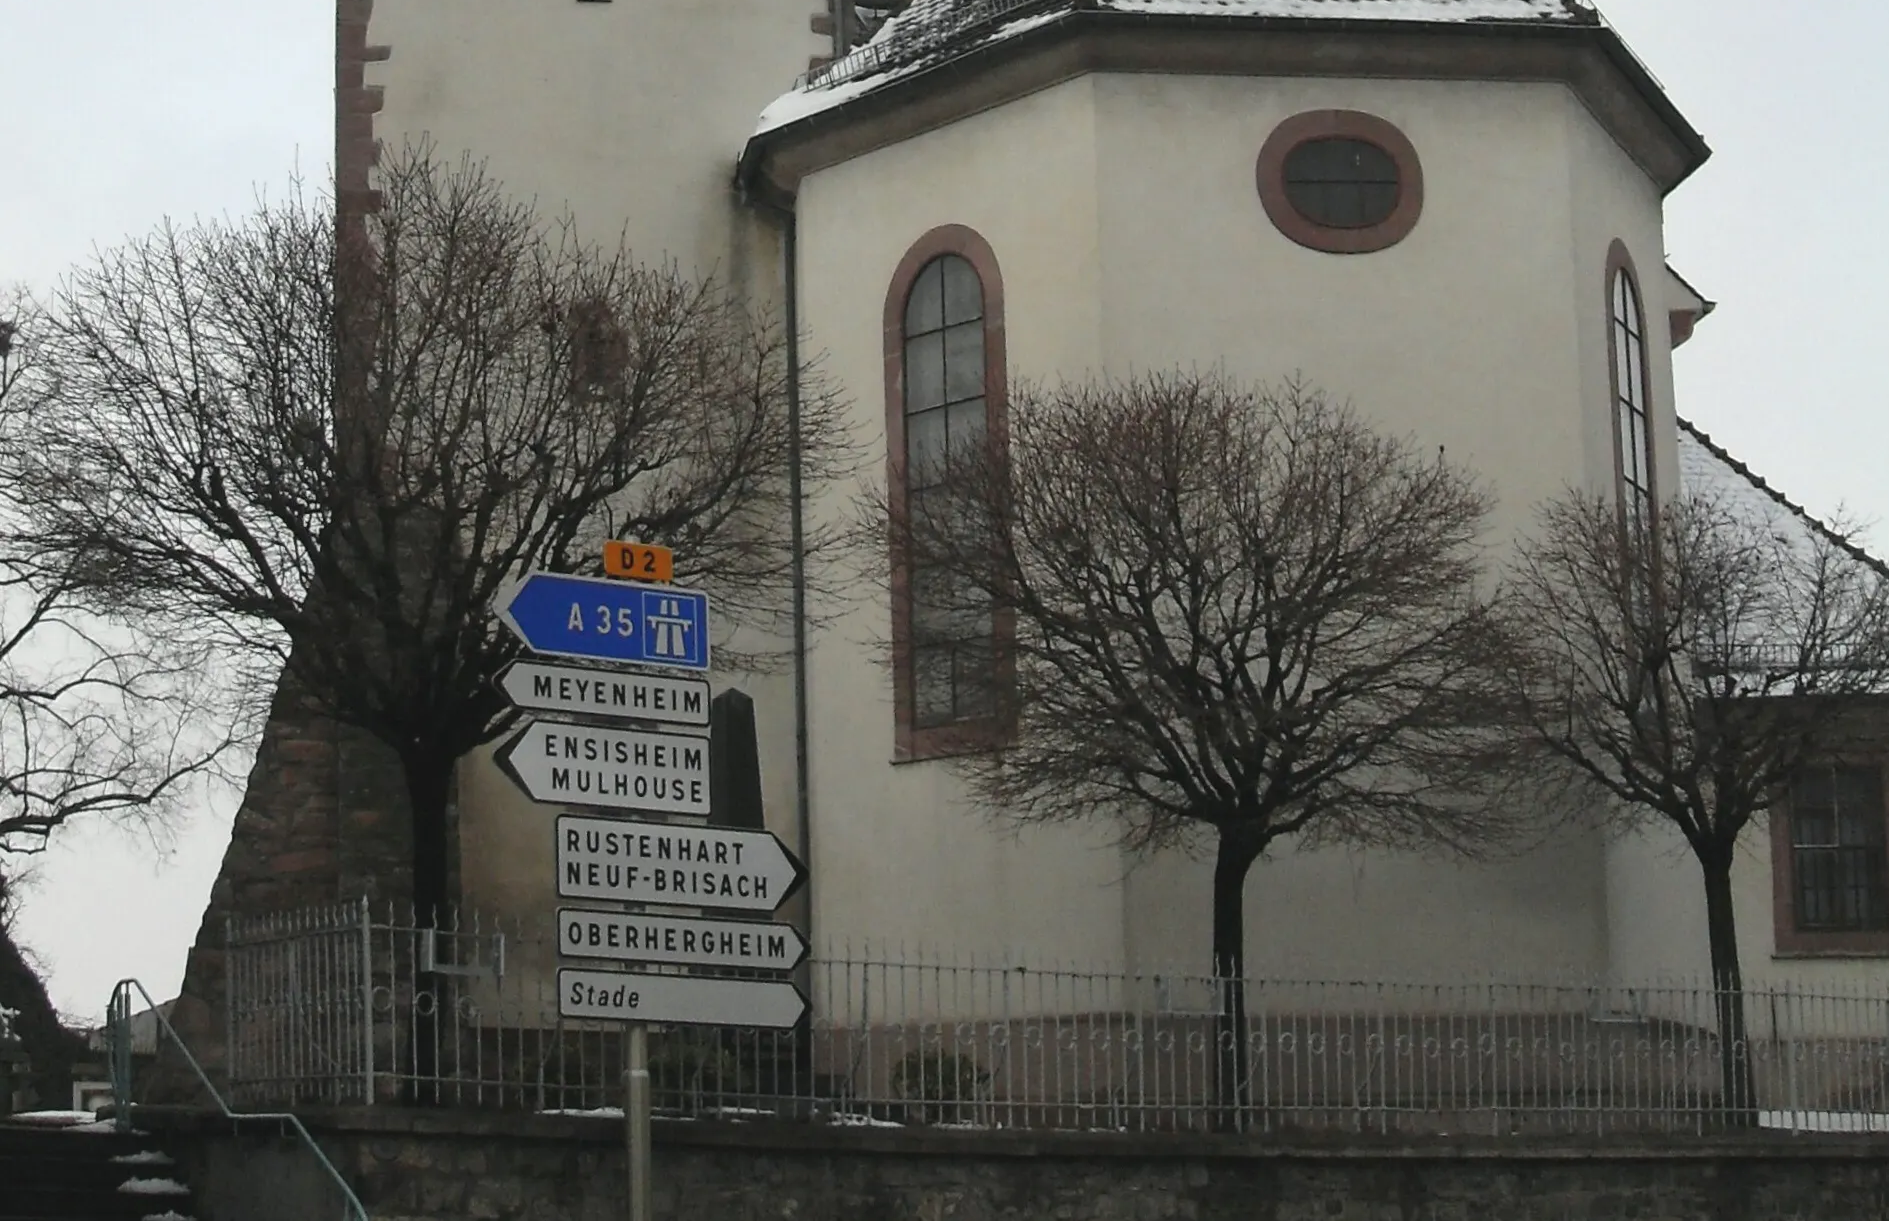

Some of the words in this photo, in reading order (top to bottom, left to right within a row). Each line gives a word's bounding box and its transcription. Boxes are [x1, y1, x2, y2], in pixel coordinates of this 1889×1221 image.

[621, 548, 635, 571] D
[643, 552, 657, 574] 2
[567, 602, 584, 632] A
[596, 605, 634, 636] 35
[533, 675, 702, 714] MEYENHEIM
[545, 734, 702, 771] ENSISHEIM
[551, 768, 703, 803] MULHOUSE
[566, 828, 745, 865] RUSTENHART
[566, 862, 768, 899] NEUF-BRISACH
[567, 922, 786, 958] OBERHERGHEIM
[570, 981, 640, 1008] Stade
